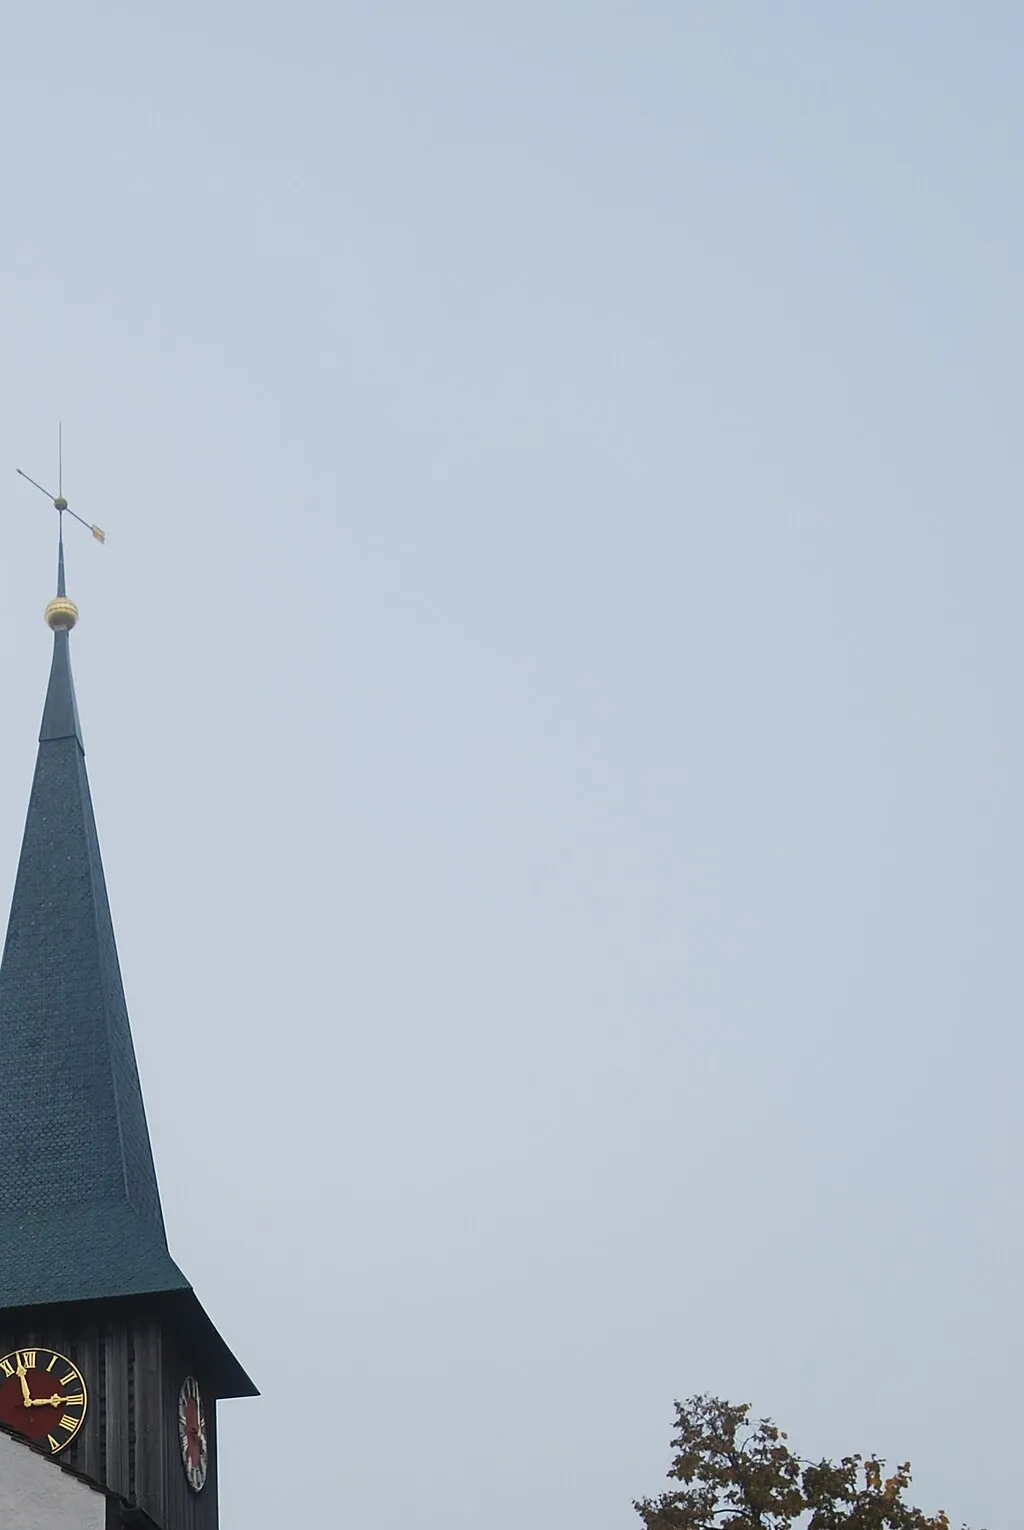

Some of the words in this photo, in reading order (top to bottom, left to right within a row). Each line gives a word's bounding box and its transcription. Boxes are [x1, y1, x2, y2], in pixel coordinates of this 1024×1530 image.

[22, 1351, 37, 1369] XII
[46, 1355, 58, 1372] I
[59, 1370, 78, 1386] II
[66, 1393, 84, 1406] III
[58, 1414, 80, 1433] IIII
[47, 1433, 61, 1451] V
